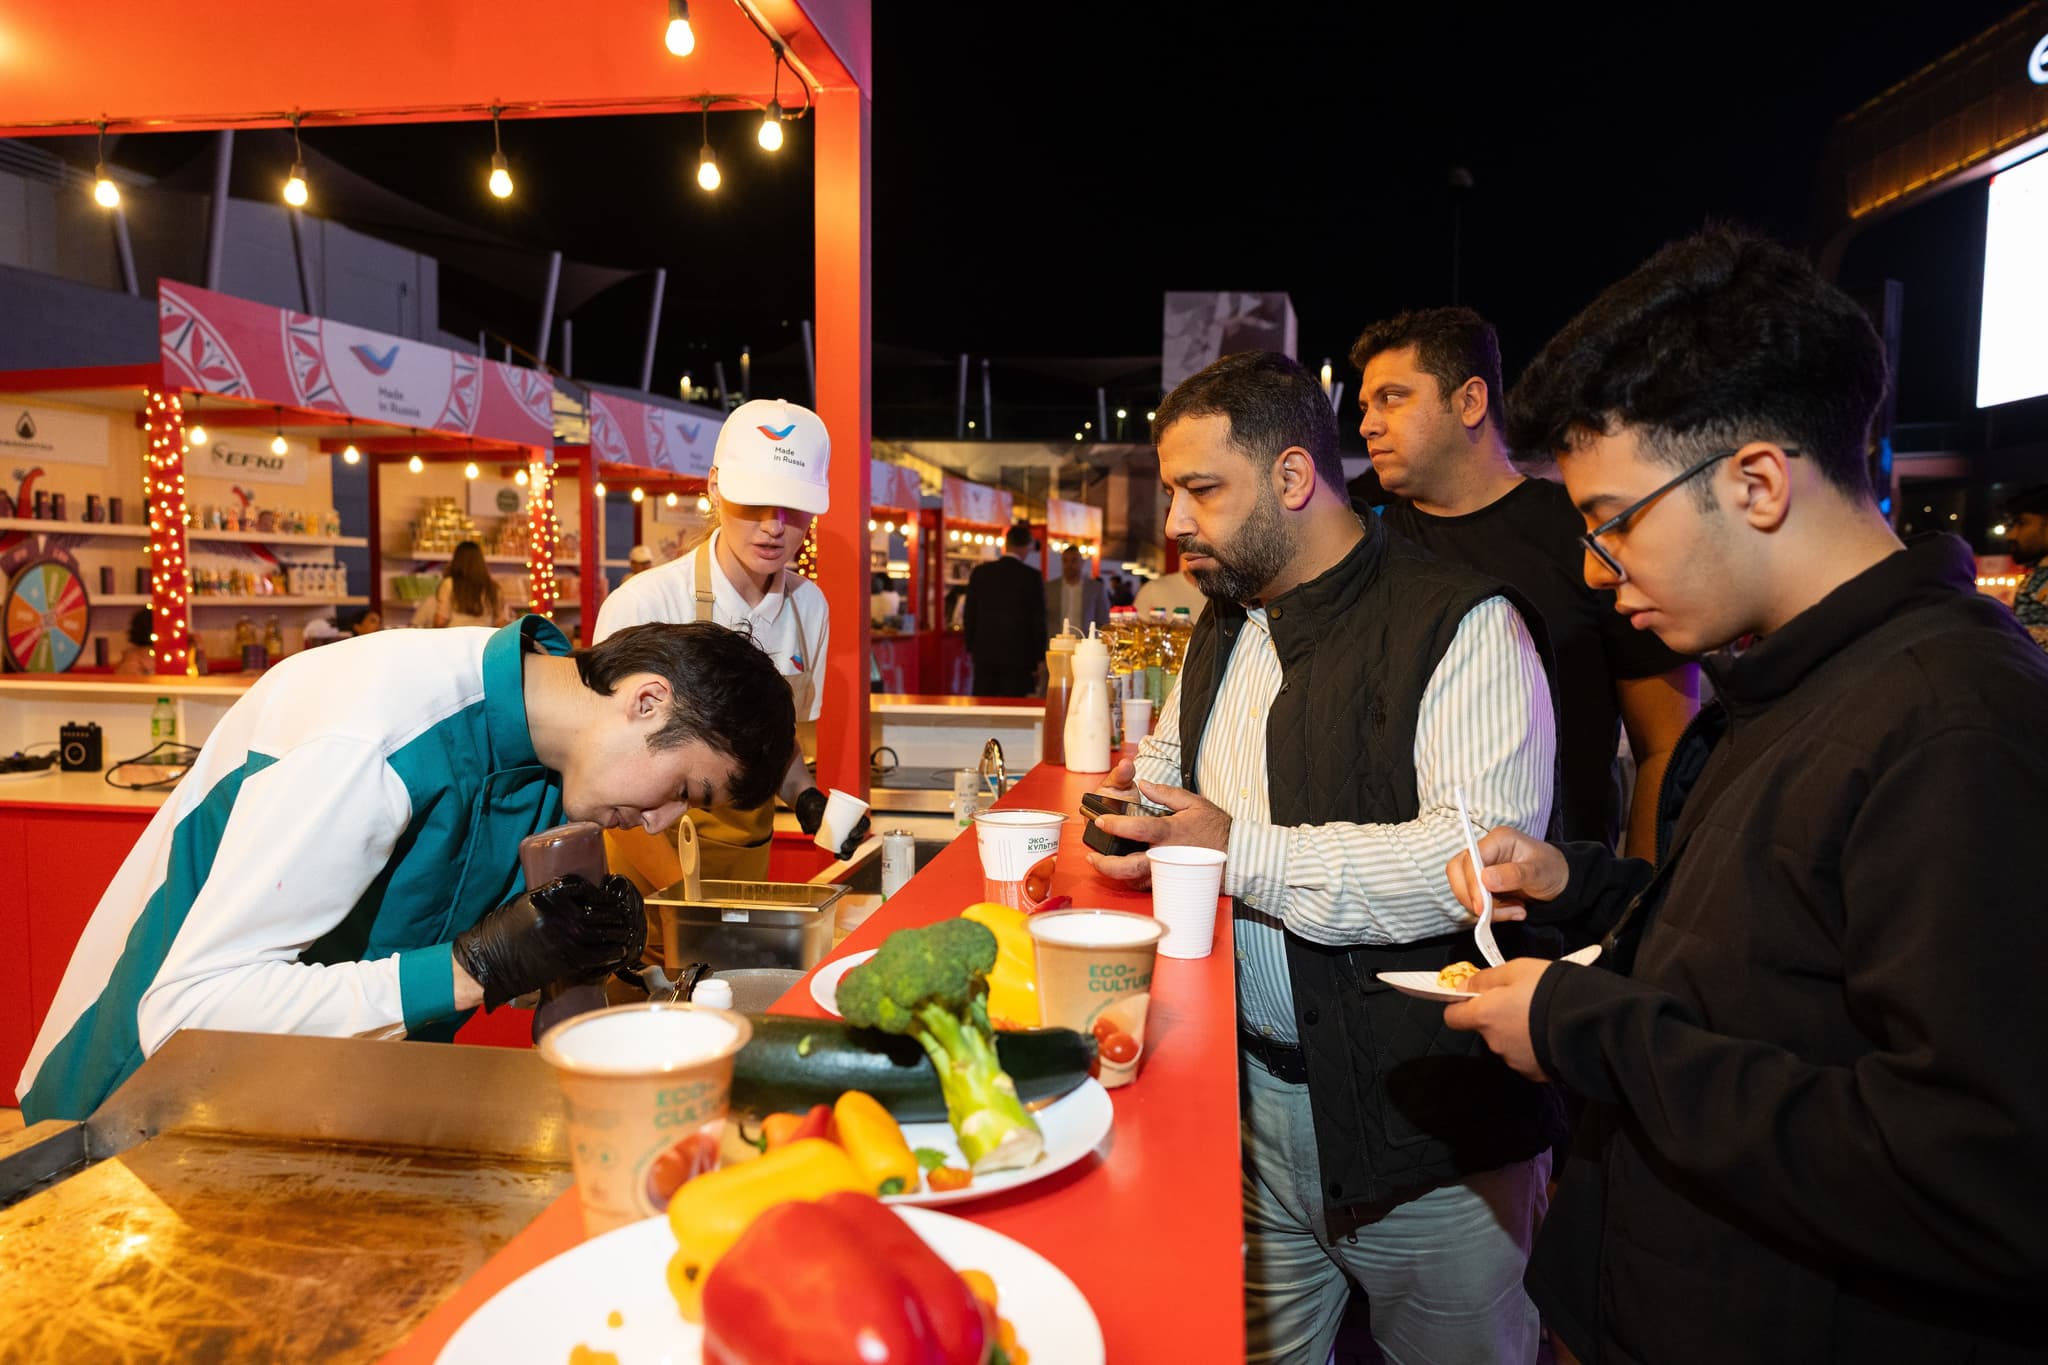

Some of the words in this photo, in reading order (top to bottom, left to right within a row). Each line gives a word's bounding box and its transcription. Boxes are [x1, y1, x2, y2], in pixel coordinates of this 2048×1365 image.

[378, 386, 404, 400] Made
[775, 446, 795, 456] Made
[783, 455, 805, 467] Russia
[1089, 964, 1137, 978] ECO-
